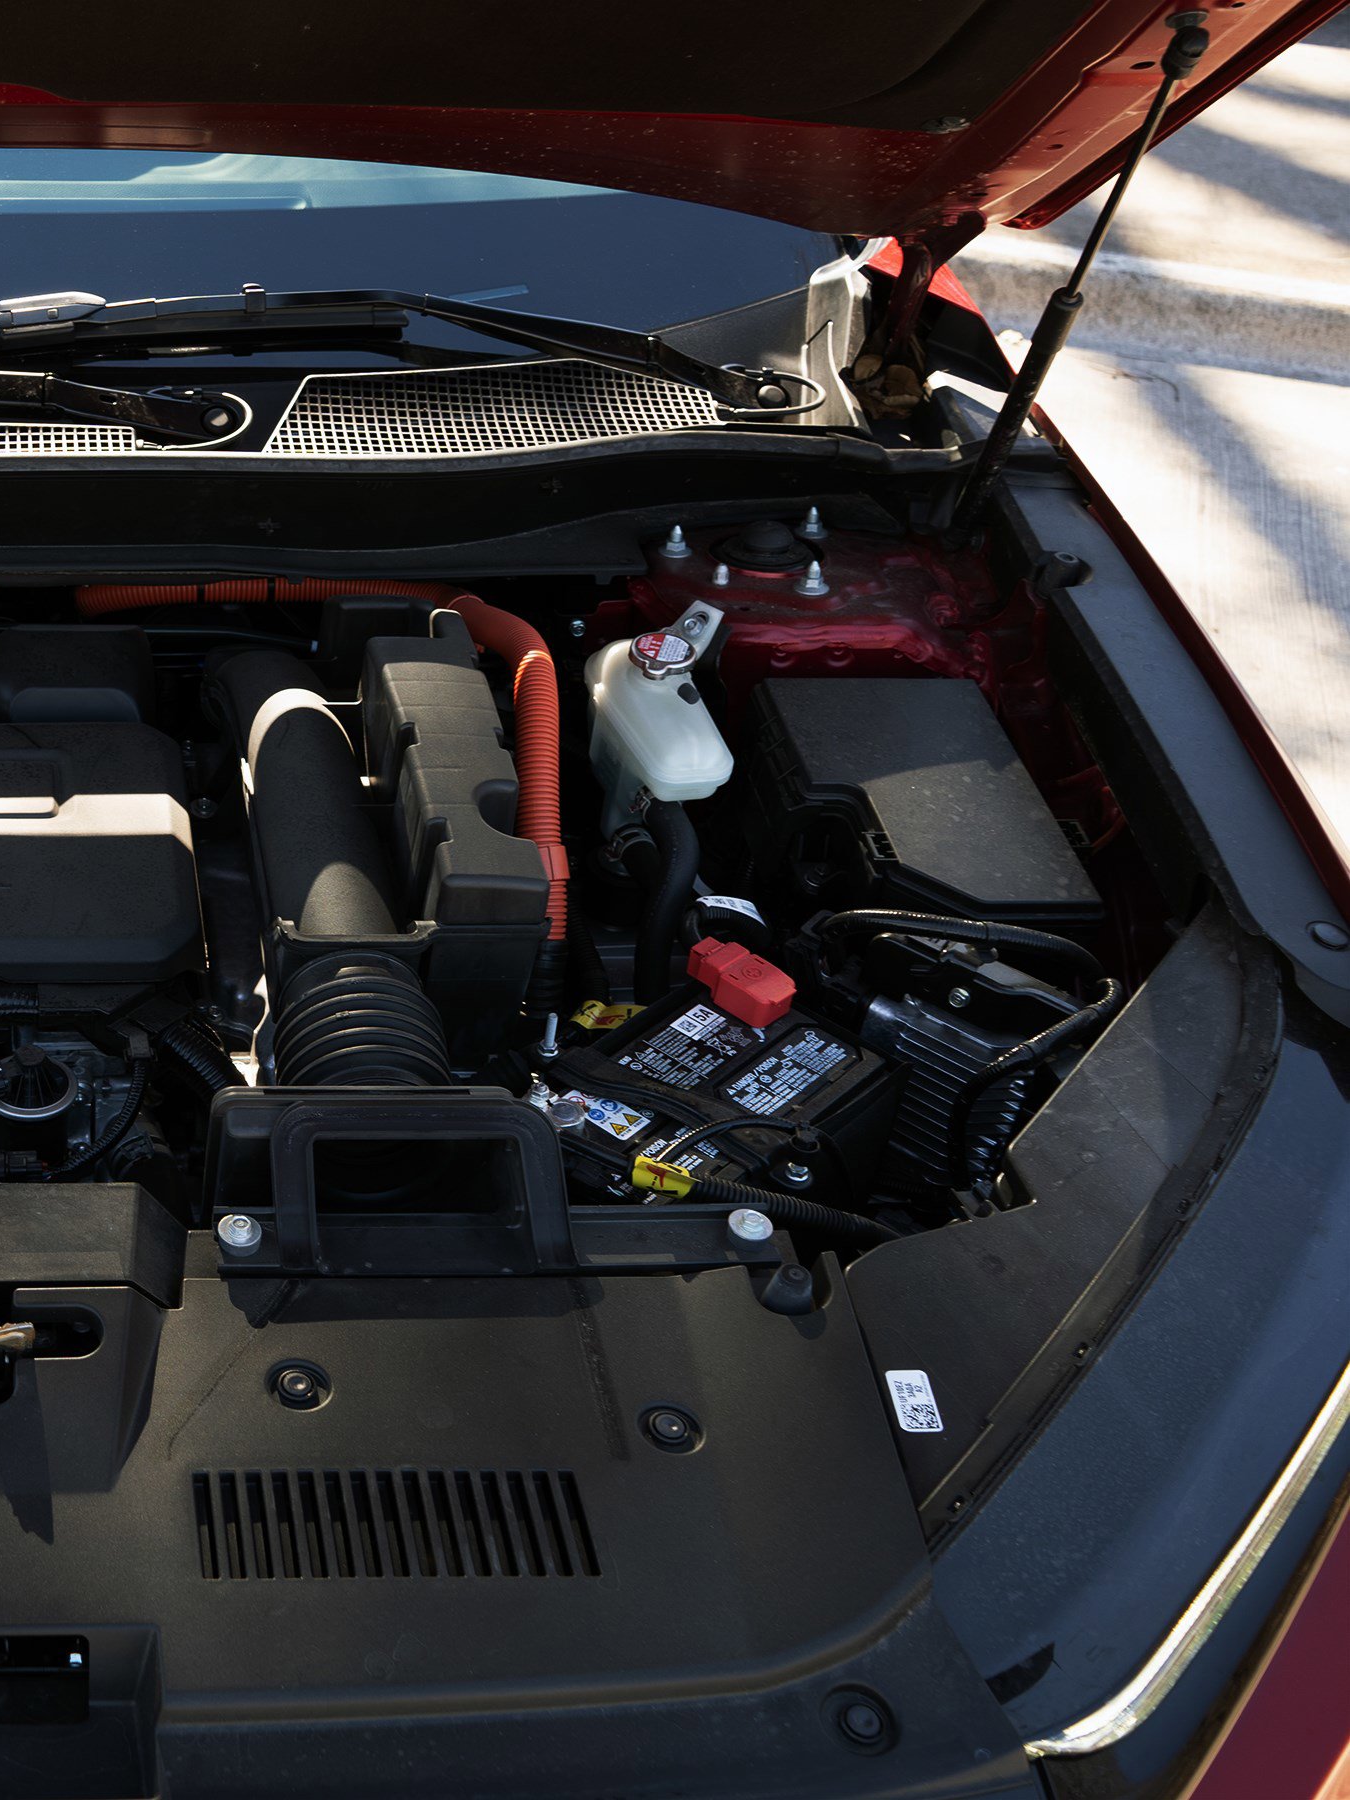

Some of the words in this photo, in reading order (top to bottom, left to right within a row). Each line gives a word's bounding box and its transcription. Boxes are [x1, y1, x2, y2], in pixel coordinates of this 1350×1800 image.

[693, 1008, 714, 1022] 5A
[731, 1072, 757, 1091] DANGER
[756, 1056, 779, 1073] POISON
[643, 1138, 668, 1157] POISON
